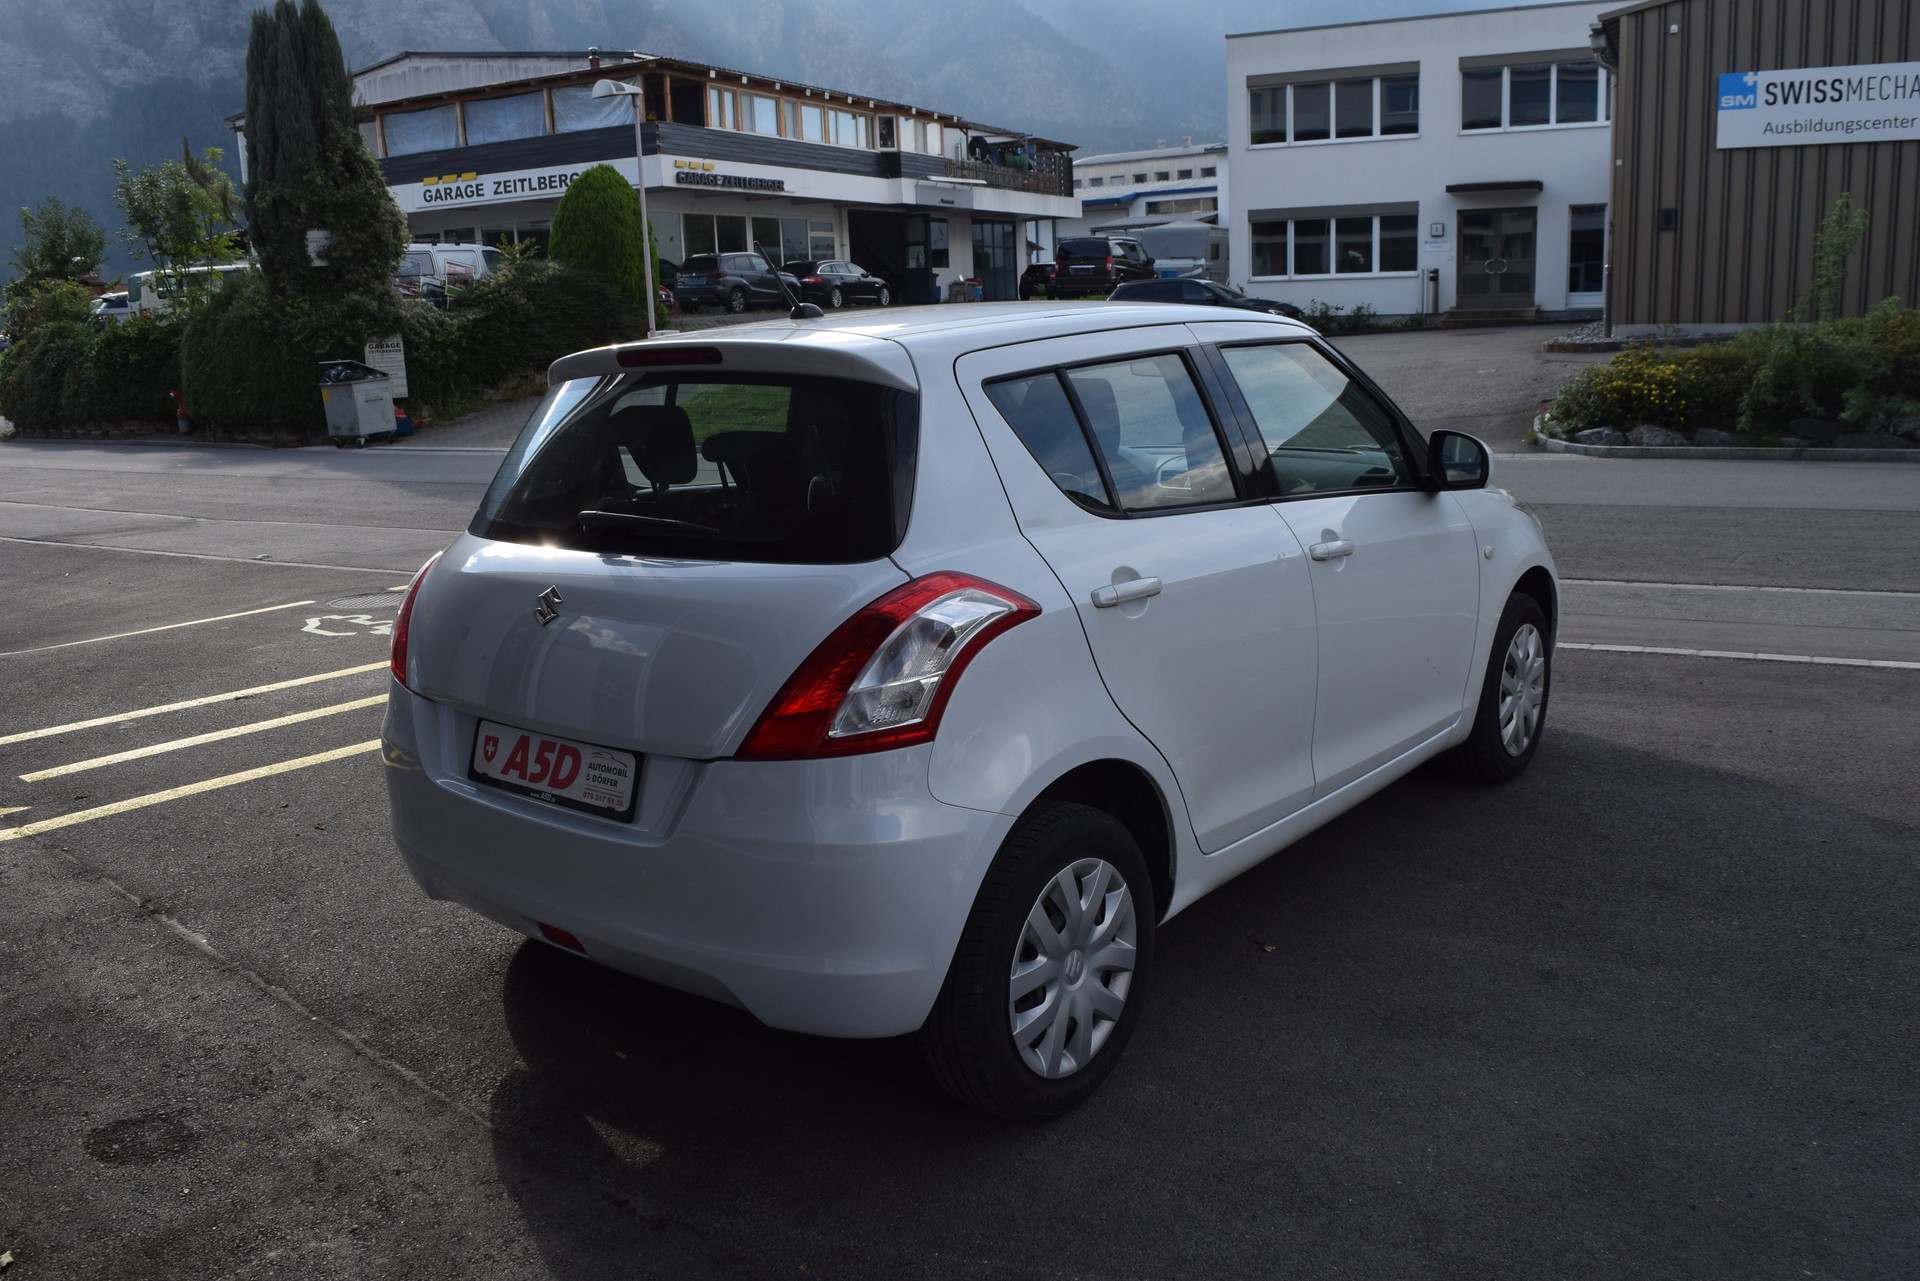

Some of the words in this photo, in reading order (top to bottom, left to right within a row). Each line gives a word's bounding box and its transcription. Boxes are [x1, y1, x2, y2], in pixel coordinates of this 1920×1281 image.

[1765, 74, 1920, 106] SWISSMECHA
[1720, 94, 1754, 107] SM
[1763, 116, 1918, 135] Ausbildungscenter
[676, 171, 722, 186] GARAGE
[722, 175, 785, 191] ZEITLBERGER
[423, 183, 485, 203] GARAGE
[501, 735, 582, 789] A5D
[587, 761, 628, 778] AUTOMOBIL
[585, 773, 591, 781] 5
[592, 773, 618, 788] DÖRFER
[582, 791, 594, 799] 079
